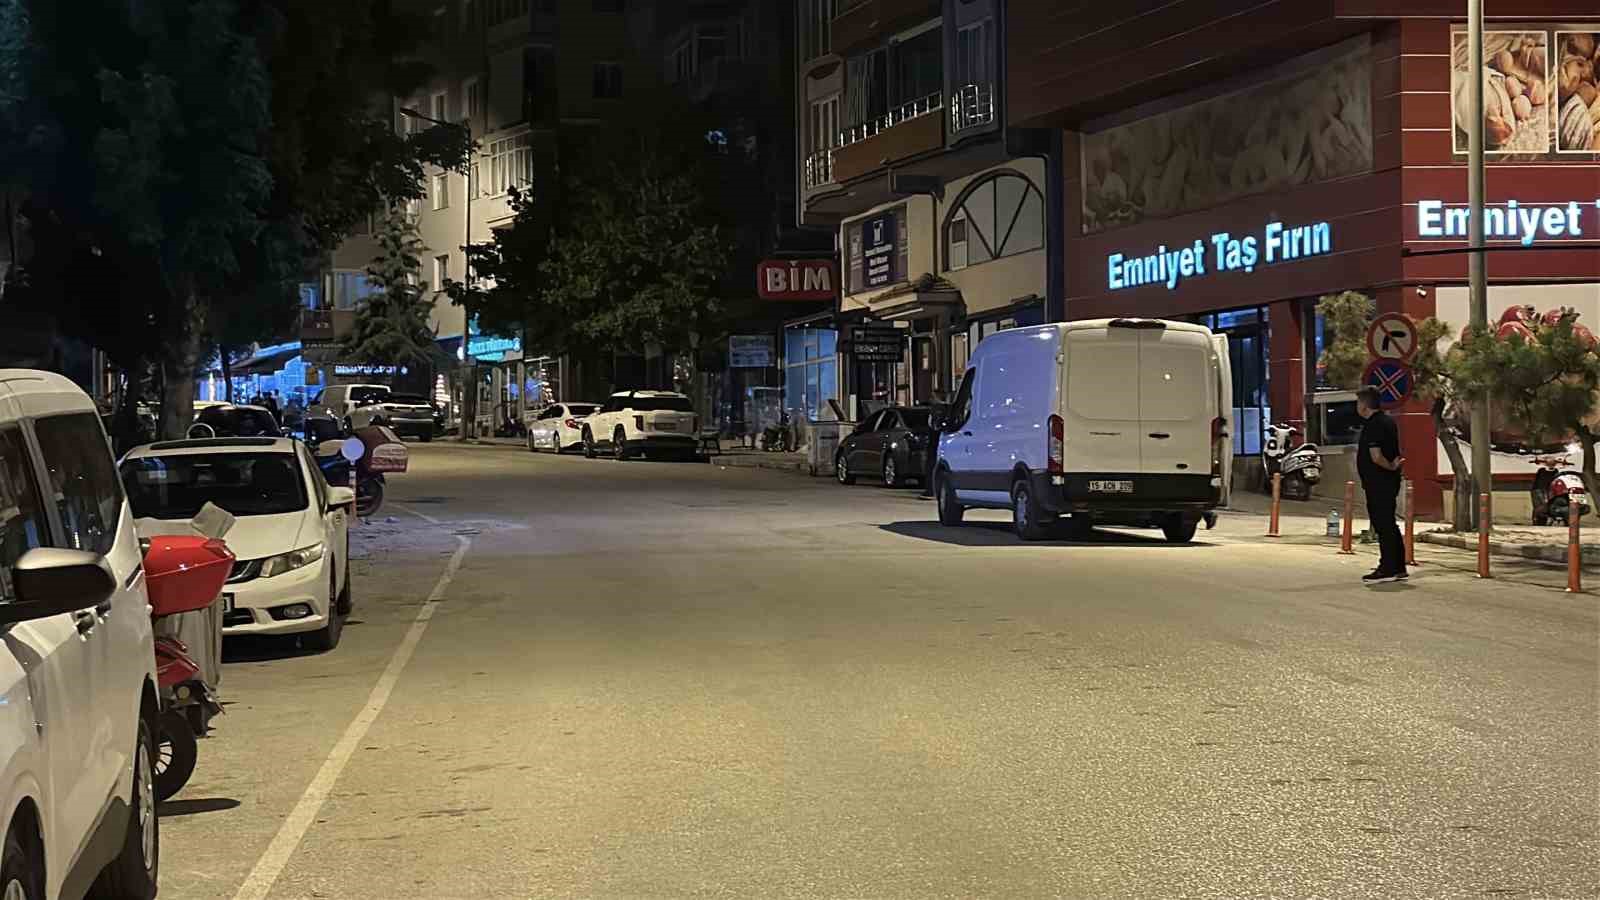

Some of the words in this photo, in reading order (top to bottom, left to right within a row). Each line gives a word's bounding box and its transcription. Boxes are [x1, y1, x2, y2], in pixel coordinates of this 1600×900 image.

[1418, 199, 1582, 247] Emniyet
[766, 260, 832, 292] BİM
[1108, 239, 1205, 290] Emniyet
[1211, 232, 1258, 273] Taş
[1265, 221, 1330, 264] Fırın
